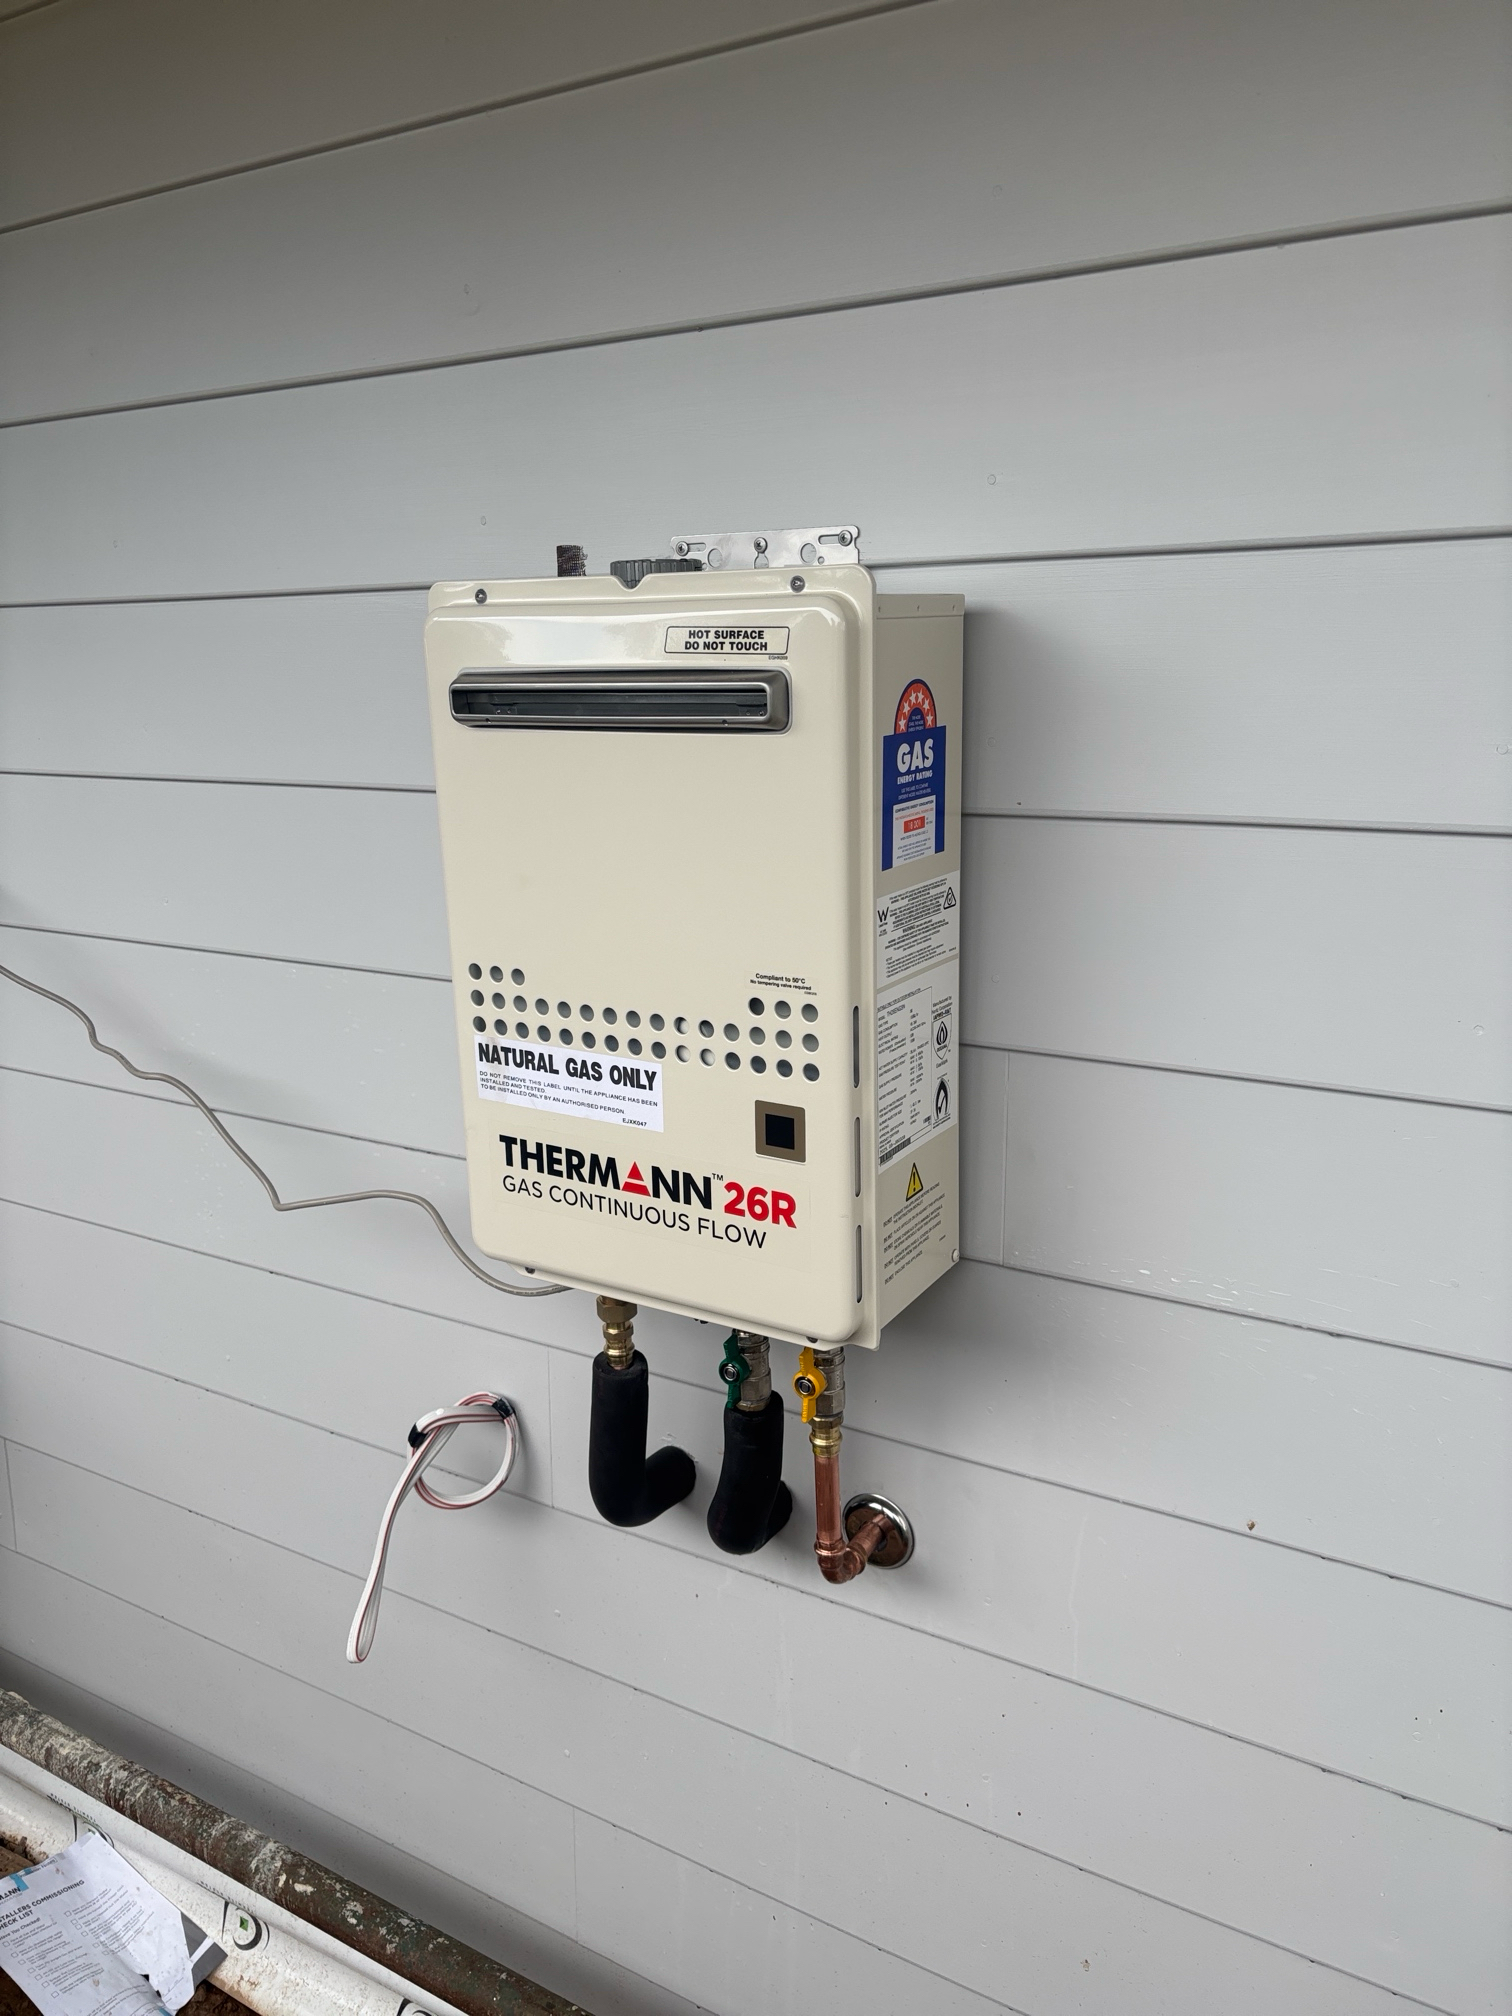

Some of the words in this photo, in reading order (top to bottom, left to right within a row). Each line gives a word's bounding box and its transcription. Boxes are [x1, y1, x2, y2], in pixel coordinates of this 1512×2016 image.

[685, 641, 699, 650] DO
[703, 641, 725, 650] NOT
[729, 642, 768, 651] TOUCH
[688, 630, 711, 639] HOT
[714, 630, 765, 640] SURFACE
[897, 738, 934, 773] GAS
[897, 773, 915, 785] ENERGY
[916, 770, 933, 780] RATING
[755, 973, 784, 981] Compliant
[478, 1042, 559, 1075] NATURAL
[565, 1057, 603, 1082] GAS
[609, 1065, 657, 1091] ONLY
[480, 1077, 509, 1087] INSTALLED
[503, 1075, 526, 1083] REMOVE
[543, 1082, 561, 1090] LABEL
[563, 1085, 580, 1093] UNTIL
[593, 1091, 626, 1101] APPLIANCE
[641, 1099, 658, 1107] BEEN
[497, 1087, 527, 1096] INSTALLED
[561, 1098, 599, 1110] AUTHORISED
[499, 1134, 712, 1210] THERMANN
[724, 1181, 797, 1229] 26R
[502, 1175, 543, 1198] GAS
[549, 1185, 690, 1232] CONTINUOUS
[698, 1217, 767, 1249] FLOW
[32, 1879, 85, 1907] COMMISSIONING
[18, 1910, 34, 1921] LIST
